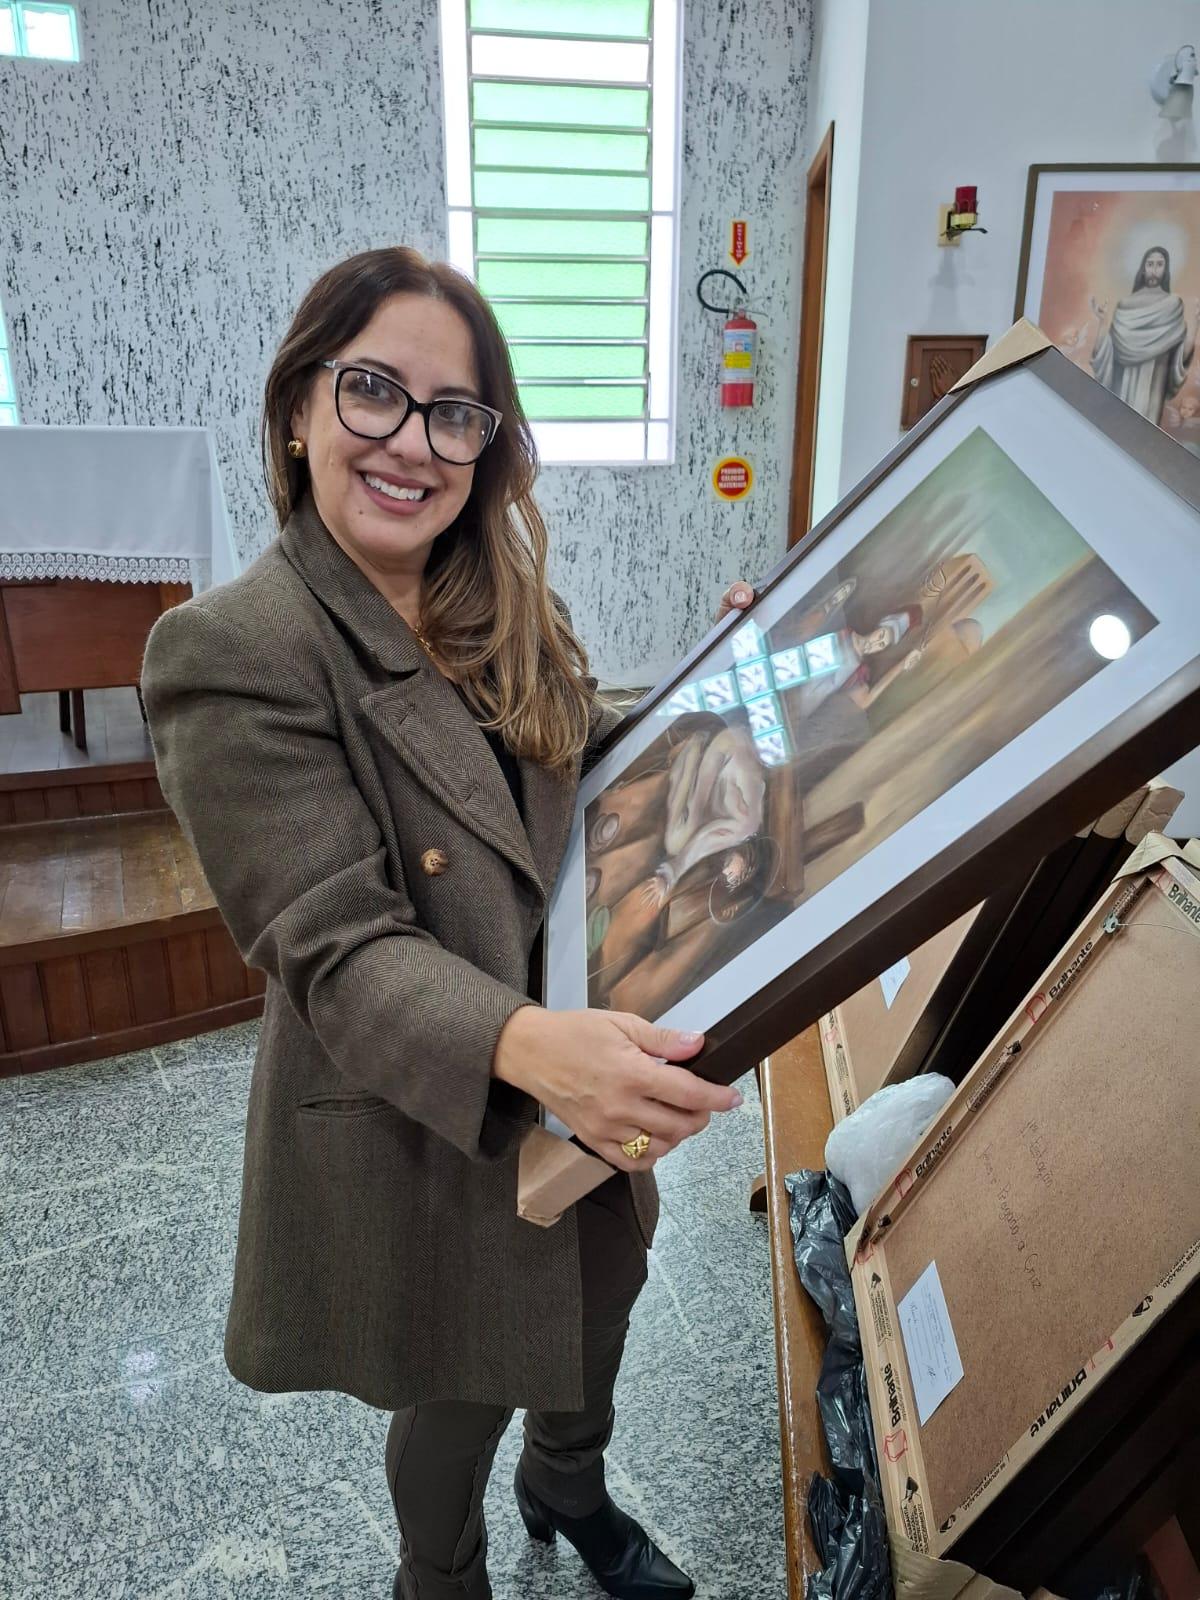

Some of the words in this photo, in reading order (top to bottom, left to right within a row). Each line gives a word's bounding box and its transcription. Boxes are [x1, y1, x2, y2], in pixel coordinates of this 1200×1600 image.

[1049, 941, 1093, 999] Brilhante
[915, 1126, 952, 1178] Brilhante
[1023, 1253, 1042, 1289] Cruz
[884, 1362, 901, 1428] Brilhante
